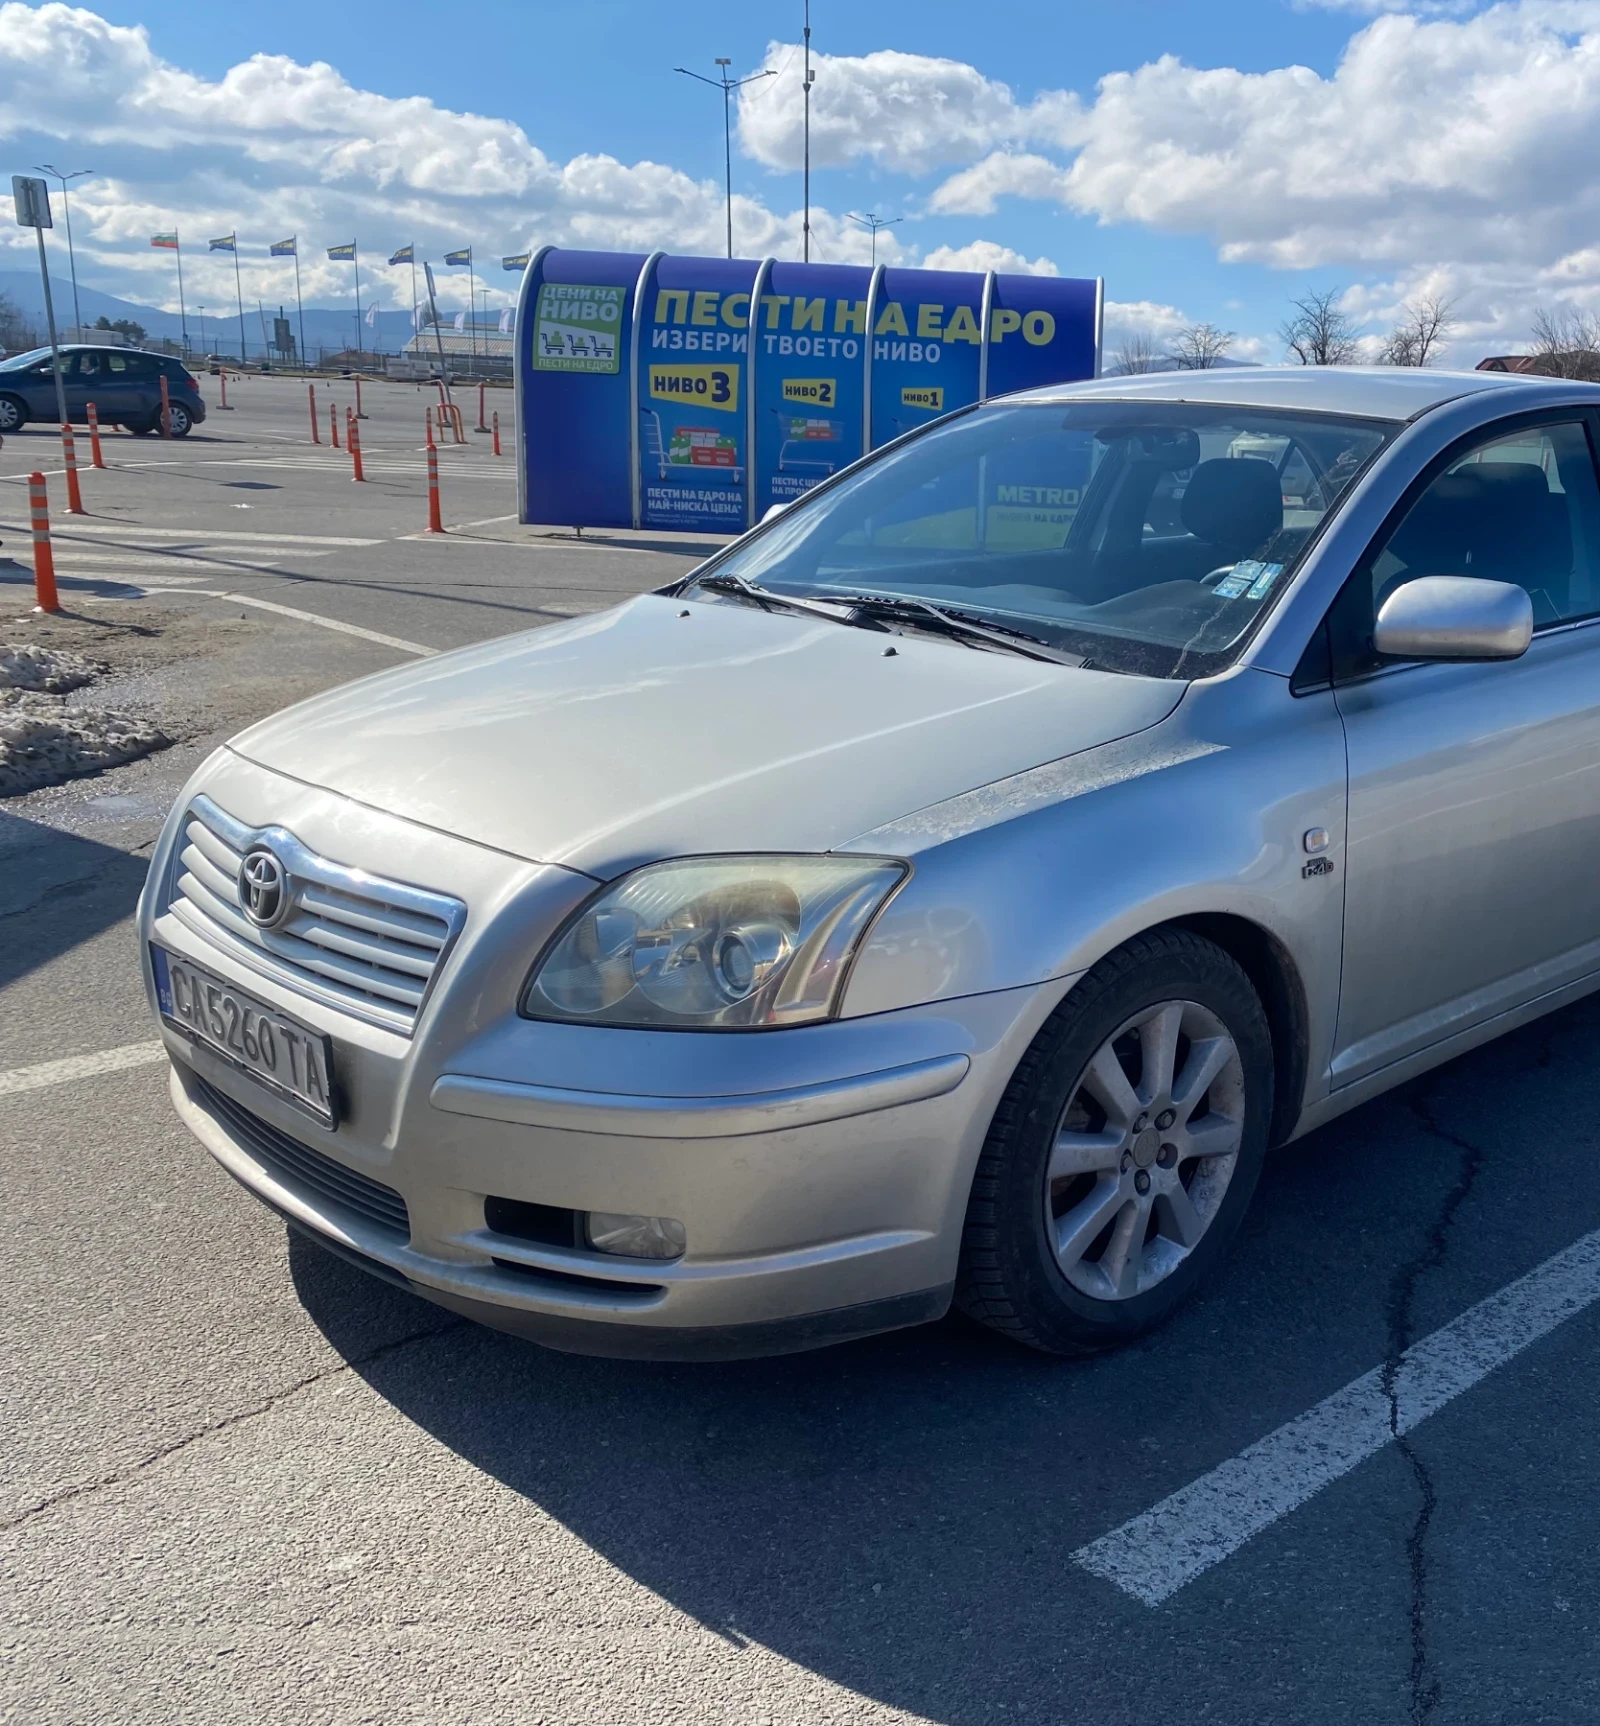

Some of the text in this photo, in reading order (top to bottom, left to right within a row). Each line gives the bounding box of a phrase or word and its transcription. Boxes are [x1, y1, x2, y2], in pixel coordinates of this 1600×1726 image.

[543, 287, 618, 301] ЦЕНИ НА
[540, 300, 618, 322] НИВО
[654, 289, 1056, 346] ПЕСТИ НА ЕДРО
[652, 328, 941, 363] ИЗБЕРИ ТВОЕТО НИВО
[539, 358, 613, 371] ПЕСТИ НА ЕДРО
[653, 371, 731, 403] НИВО 3
[785, 383, 831, 402] НИВО 2
[903, 391, 939, 406] НИВО 1
[772, 476, 798, 486] ПЕСТИ
[647, 487, 742, 502] ПЕСТИ НА ЕДРО НА
[772, 486, 785, 494] НА
[997, 485, 1079, 505] METRO
[648, 498, 709, 512] НАЙ-НИСКА
[160, 988, 172, 1007] BG
